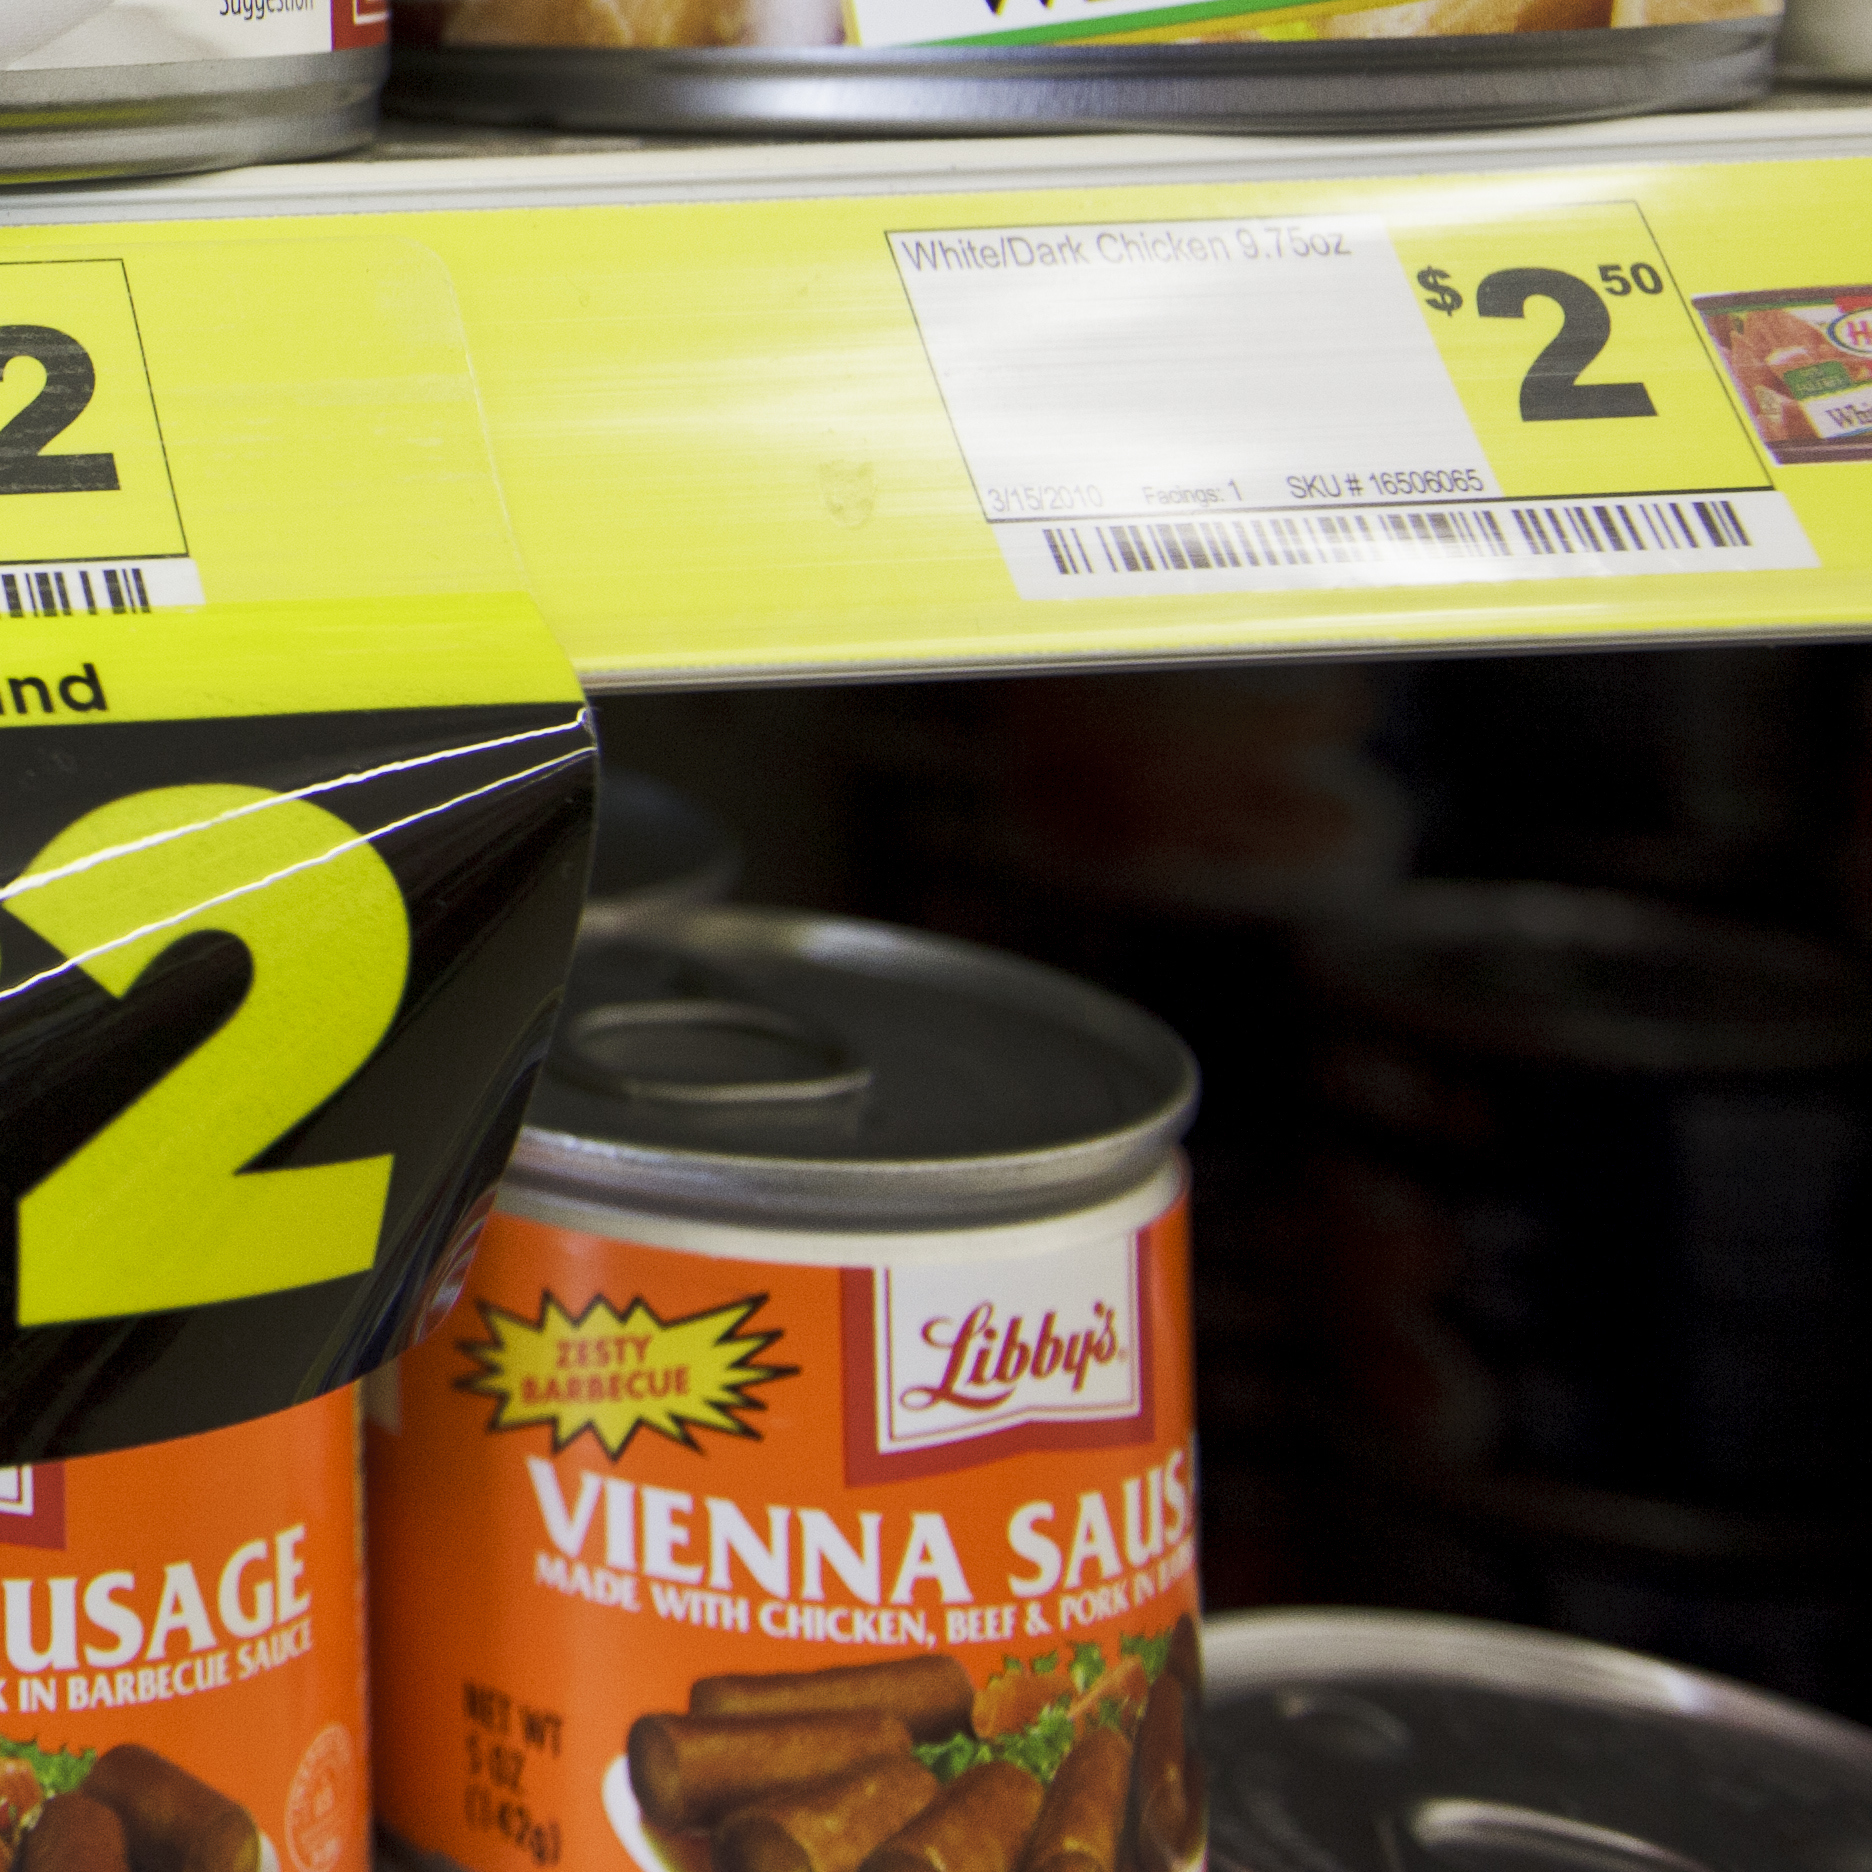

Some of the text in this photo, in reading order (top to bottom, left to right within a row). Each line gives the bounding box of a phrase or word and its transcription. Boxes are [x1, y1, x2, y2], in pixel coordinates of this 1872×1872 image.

[902, 225, 1352, 273] White/Dark Chicken 9.75oz
[987, 468, 1485, 513] 3/15/2010 Facings: 1 SKU # 16506065
[556, 1334, 652, 1370] ZESTY
[520, 1367, 689, 1406] BARBECUE
[526, 1455, 974, 1606] VIENNA
[19, 1678, 56, 1711] IN
[67, 1653, 232, 1708] BARBECUE
[237, 1622, 313, 1681] SAUCE
